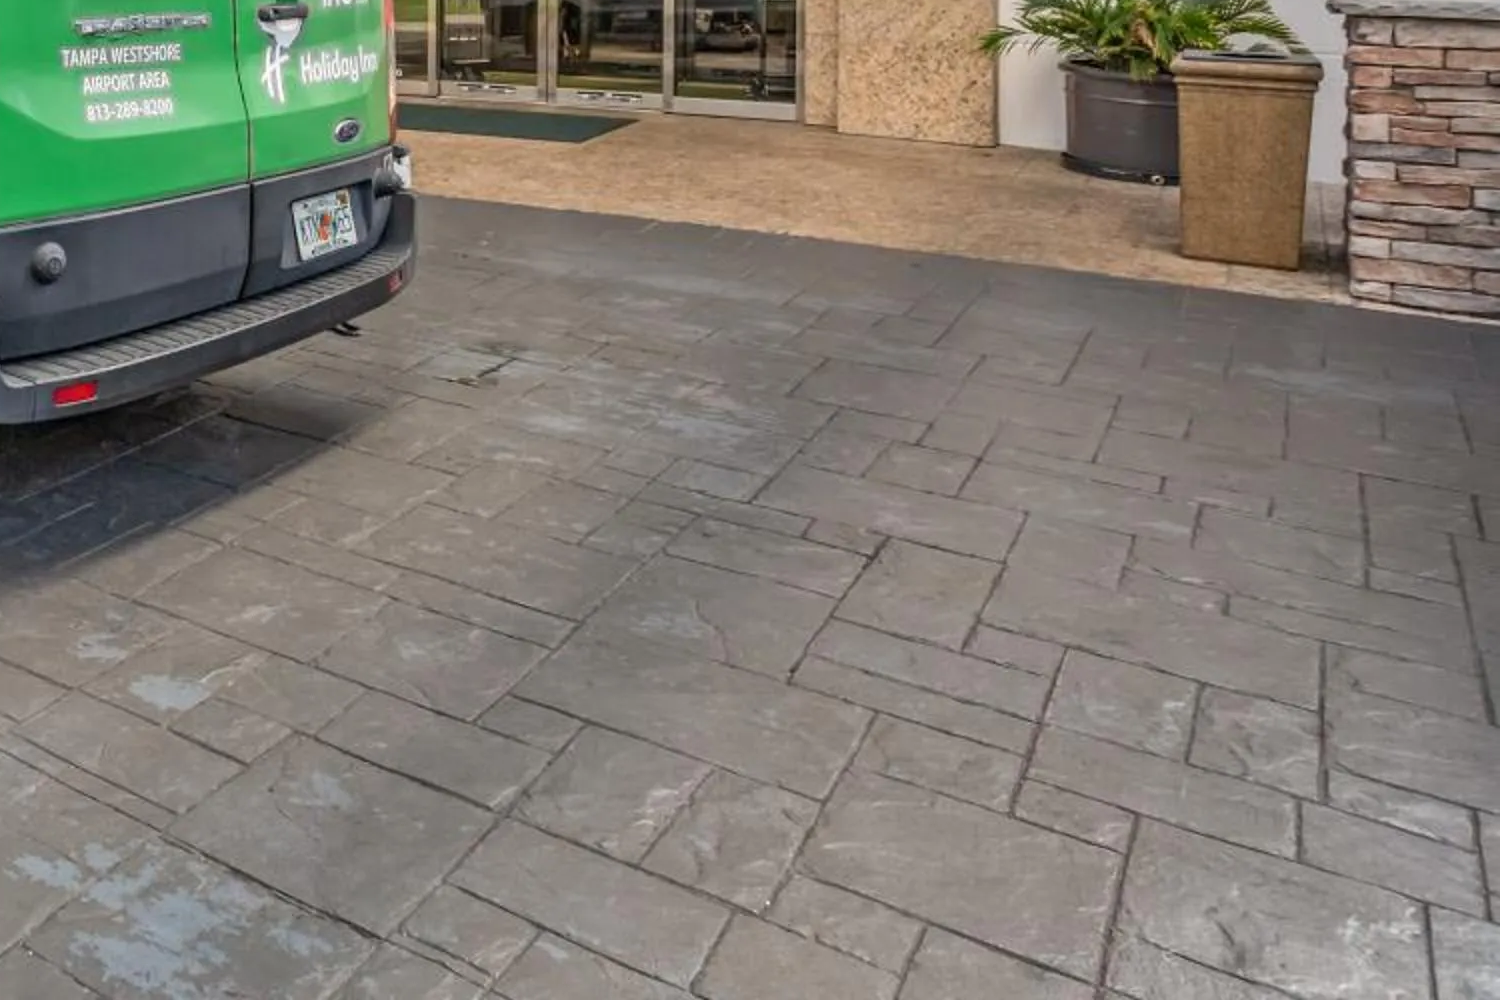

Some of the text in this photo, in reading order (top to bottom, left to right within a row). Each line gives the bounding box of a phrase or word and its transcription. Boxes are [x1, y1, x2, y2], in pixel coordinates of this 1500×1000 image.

[61, 43, 181, 68] TAMPA WESTSHORE
[300, 48, 359, 84] Holiday
[83, 71, 171, 95] AIRPORT AREA
